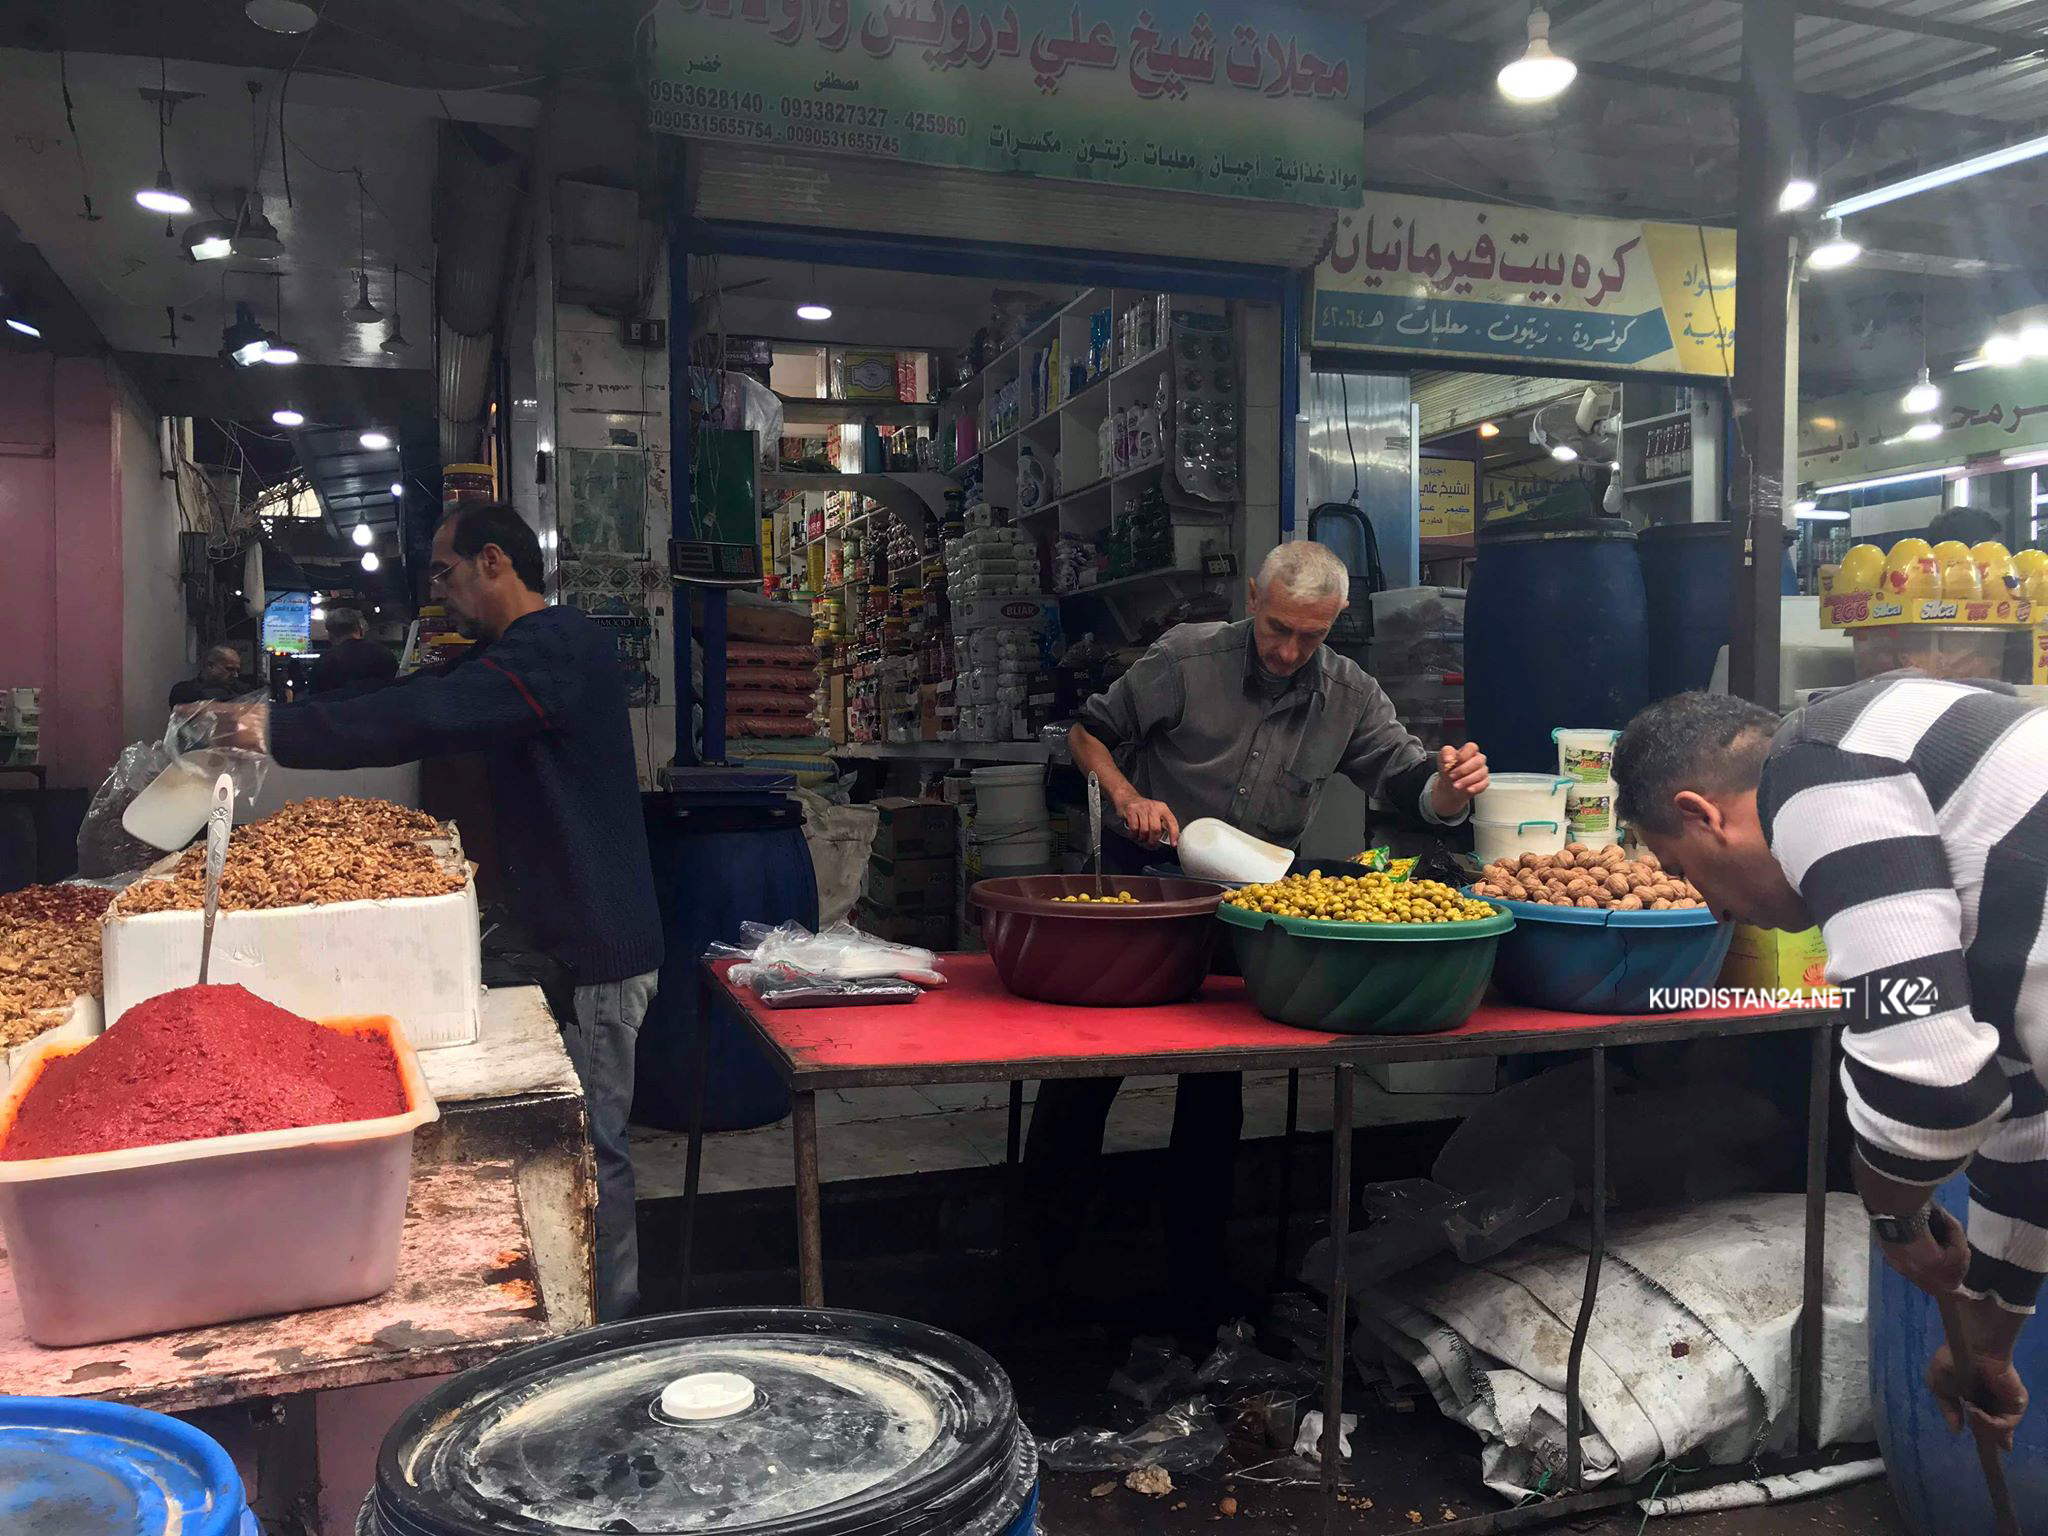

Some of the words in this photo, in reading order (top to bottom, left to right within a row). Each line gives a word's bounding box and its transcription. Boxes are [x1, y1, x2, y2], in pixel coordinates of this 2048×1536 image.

[684, 55, 722, 75] خضر
[1030, 1, 1117, 93] علي
[1129, 10, 1214, 98] شيخ
[1227, 25, 1349, 98] محلات
[650, 80, 762, 115] 0953628140
[781, 96, 888, 129] 0933827327
[905, 111, 967, 137] 425960
[787, 125, 900, 153] 0090531655745
[989, 125, 1062, 155] مكسرات
[1076, 138, 1128, 170] زيتون
[1144, 142, 1196, 174] معلبات
[1274, 155, 1326, 188] غذائية
[1330, 168, 1358, 192] مواد
[1331, 212, 1496, 295] فيرمانيان
[1499, 232, 1566, 305] بيت
[1571, 235, 1642, 308] كره
[1396, 304, 1469, 343] معلبات
[1488, 314, 1550, 350] زيتون
[1571, 317, 1639, 353] كونسروة
[1439, 480, 1470, 498] الشيخ
[1831, 601, 1869, 624] EGG
